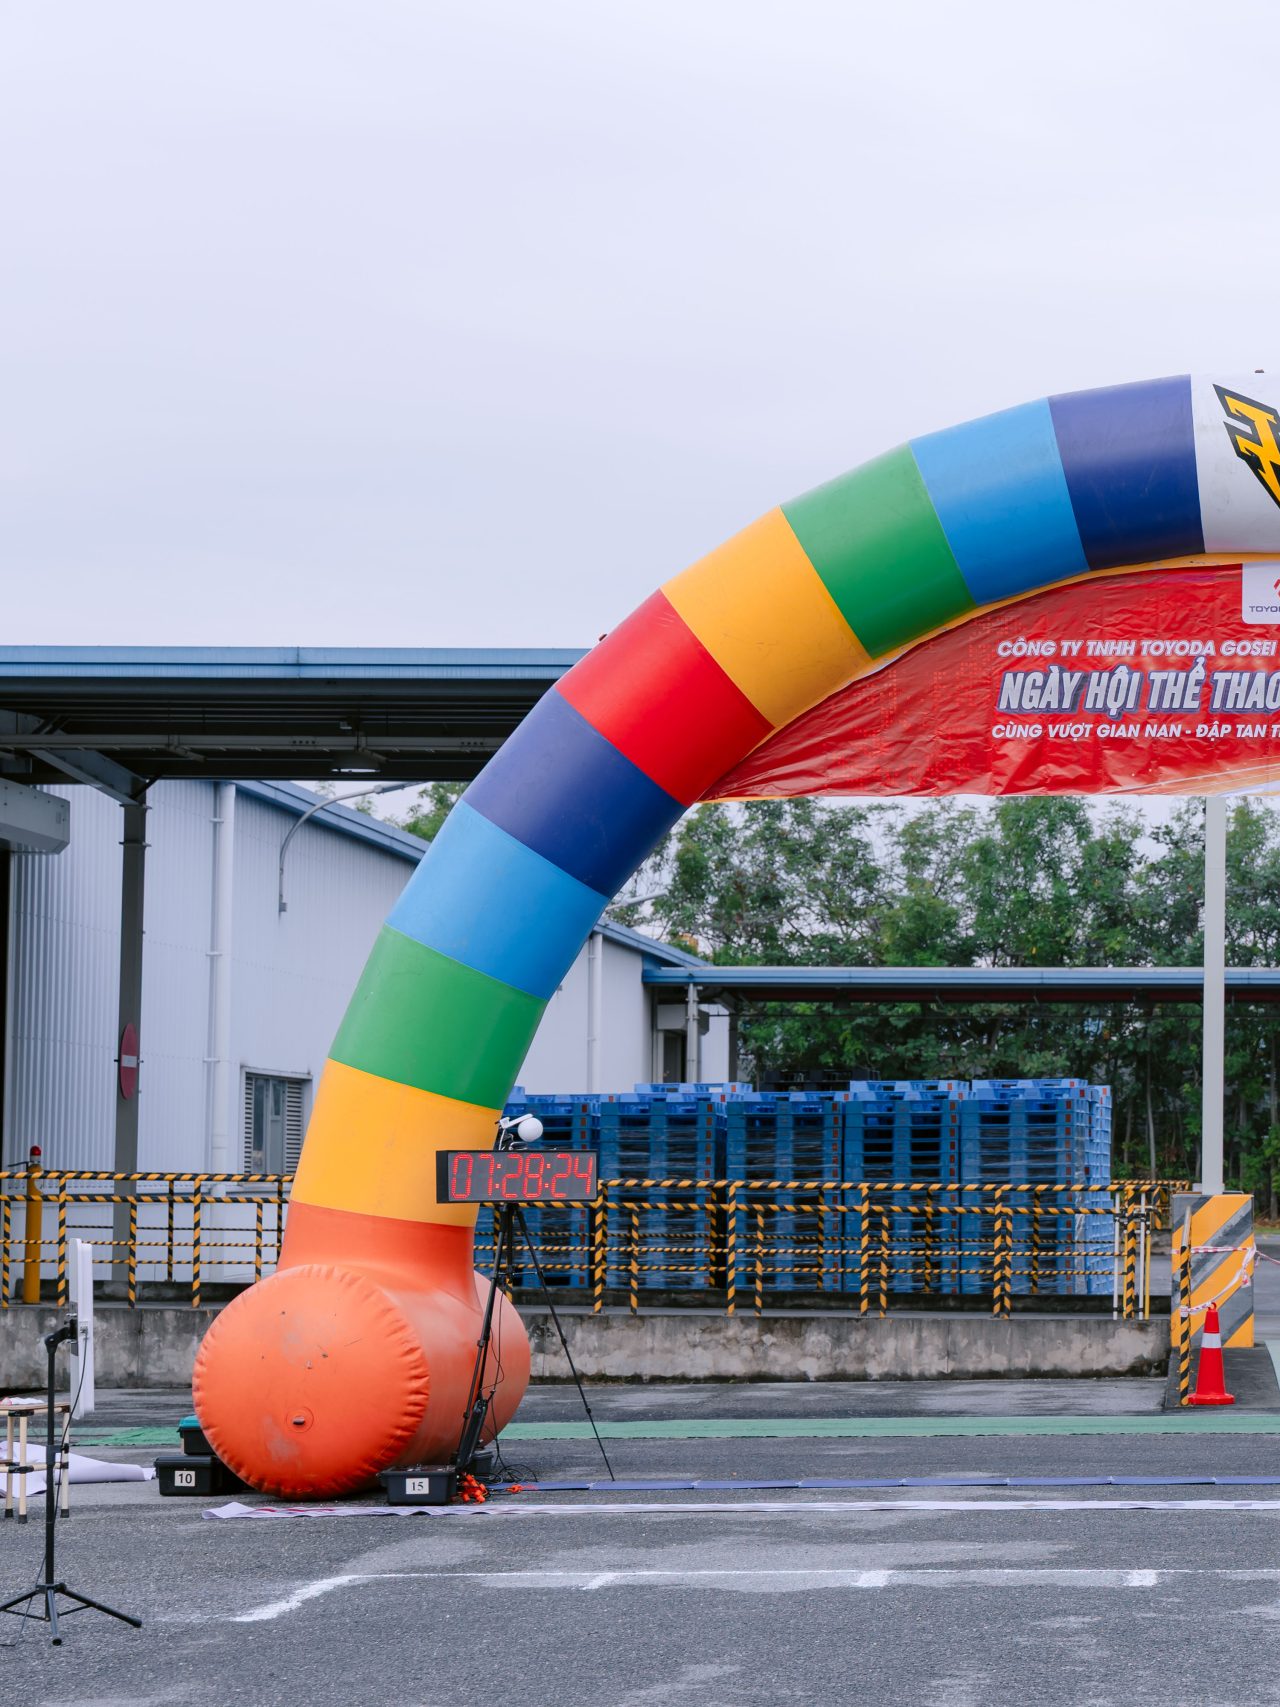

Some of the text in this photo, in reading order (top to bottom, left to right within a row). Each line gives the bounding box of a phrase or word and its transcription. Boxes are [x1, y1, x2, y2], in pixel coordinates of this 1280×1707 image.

[997, 636, 1057, 657] CÔNG
[1061, 640, 1084, 657] TY
[1086, 640, 1136, 657] TNHH
[1140, 640, 1216, 657] TOYODA
[1220, 640, 1277, 657] GOSEI
[998, 664, 1084, 711] NGÀY
[1084, 664, 1142, 717] HỘI
[1147, 656, 1207, 711] THỂ
[991, 720, 1043, 739] CÙNG
[1047, 721, 1093, 742] VƯỢT
[1096, 724, 1141, 738] GIAN
[1144, 724, 1182, 738] NAN
[1195, 721, 1232, 742] ĐẬP
[1235, 724, 1267, 738] TAN
[451, 1152, 593, 1199] 07:28:24
[178, 1472, 193, 1485] 10
[410, 1480, 424, 1492] 15
